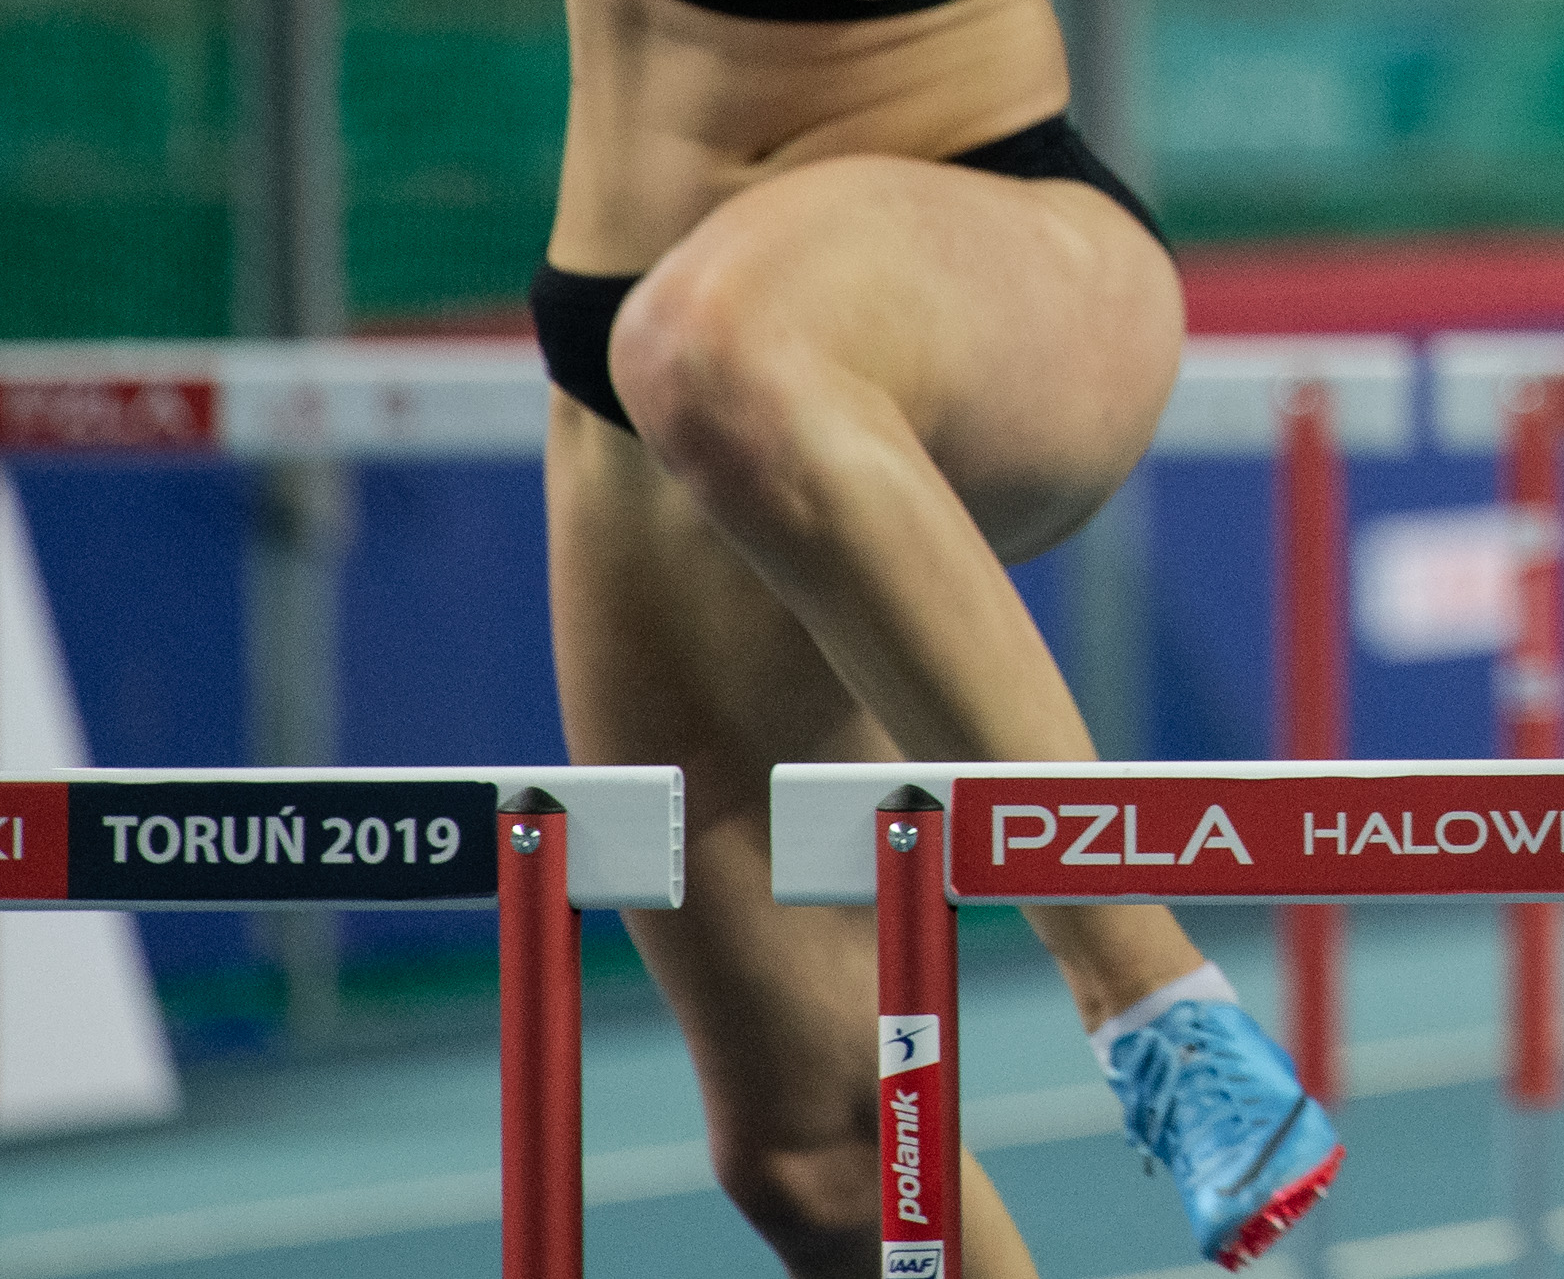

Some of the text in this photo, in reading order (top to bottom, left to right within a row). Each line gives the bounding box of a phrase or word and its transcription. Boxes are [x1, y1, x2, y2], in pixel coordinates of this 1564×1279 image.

[102, 805, 461, 864] TORUŃ 2019
[991, 804, 1254, 866] PZLA
[890, 1089, 928, 1225] polanik
[888, 1255, 936, 1275] IAAF
